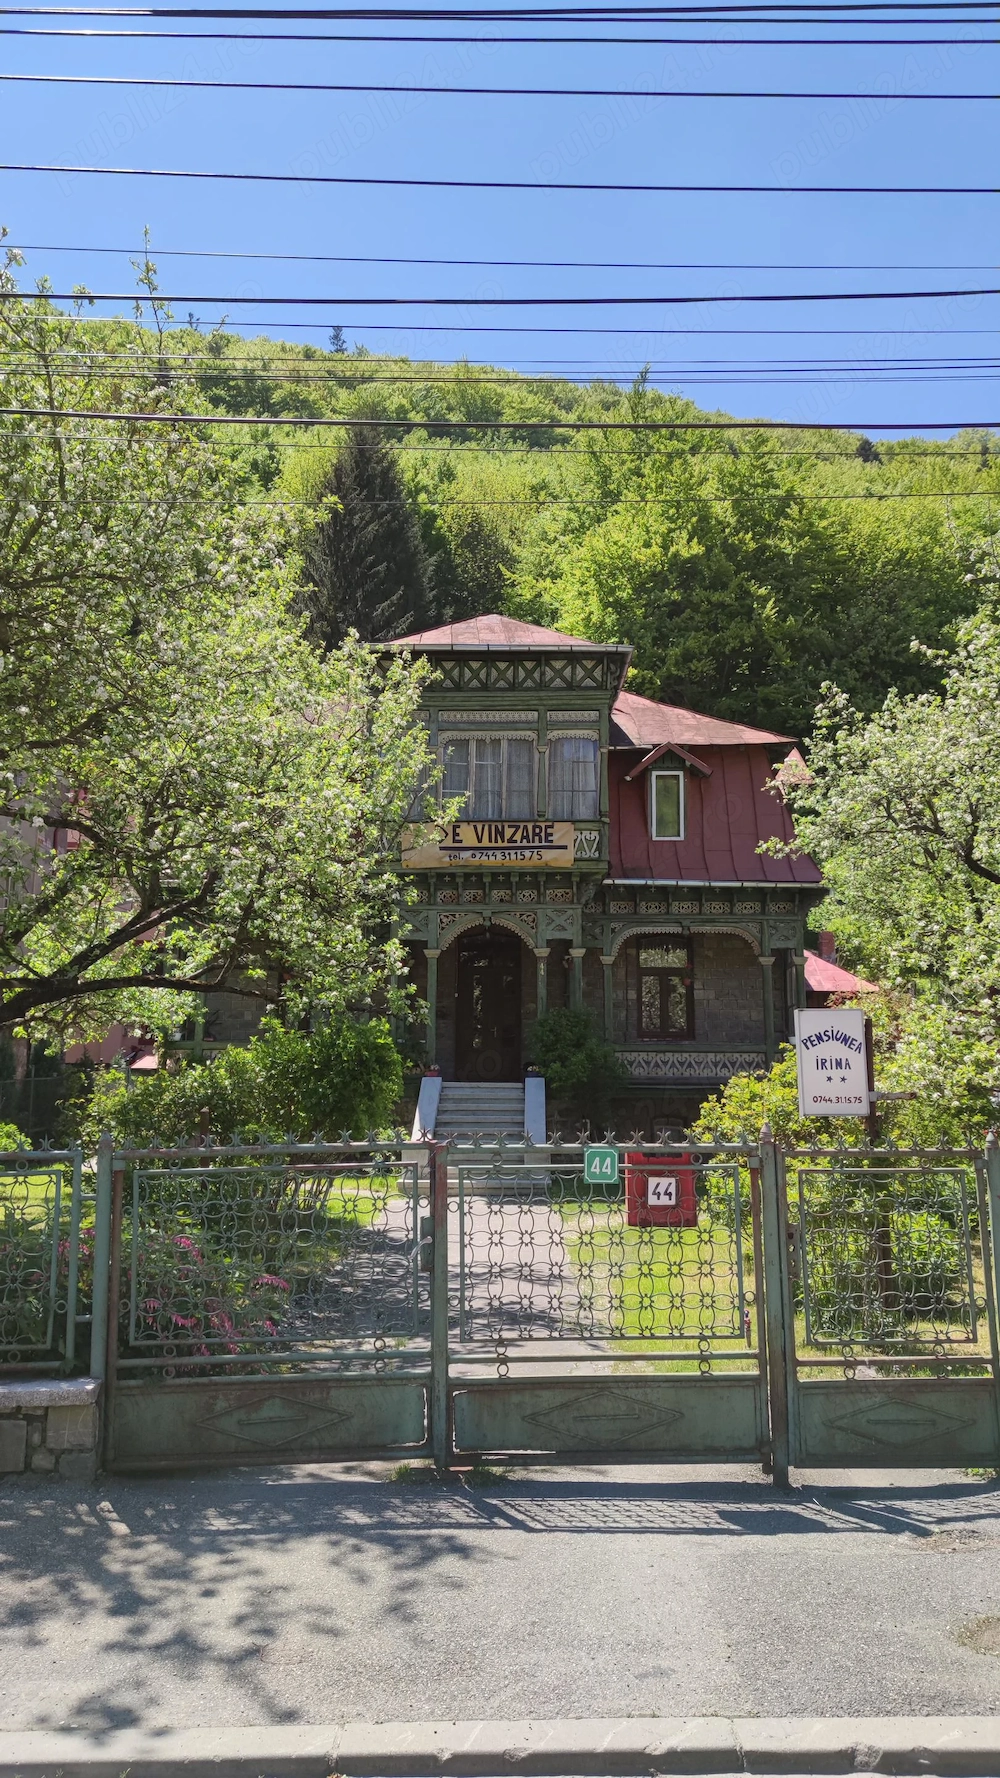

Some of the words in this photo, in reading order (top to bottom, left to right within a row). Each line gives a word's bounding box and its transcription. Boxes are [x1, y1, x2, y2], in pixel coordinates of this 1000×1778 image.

[473, 824, 554, 844] VINZARE
[448, 852, 464, 861] tel.
[590, 1156, 612, 1175] 44
[651, 1181, 673, 1201] 44
